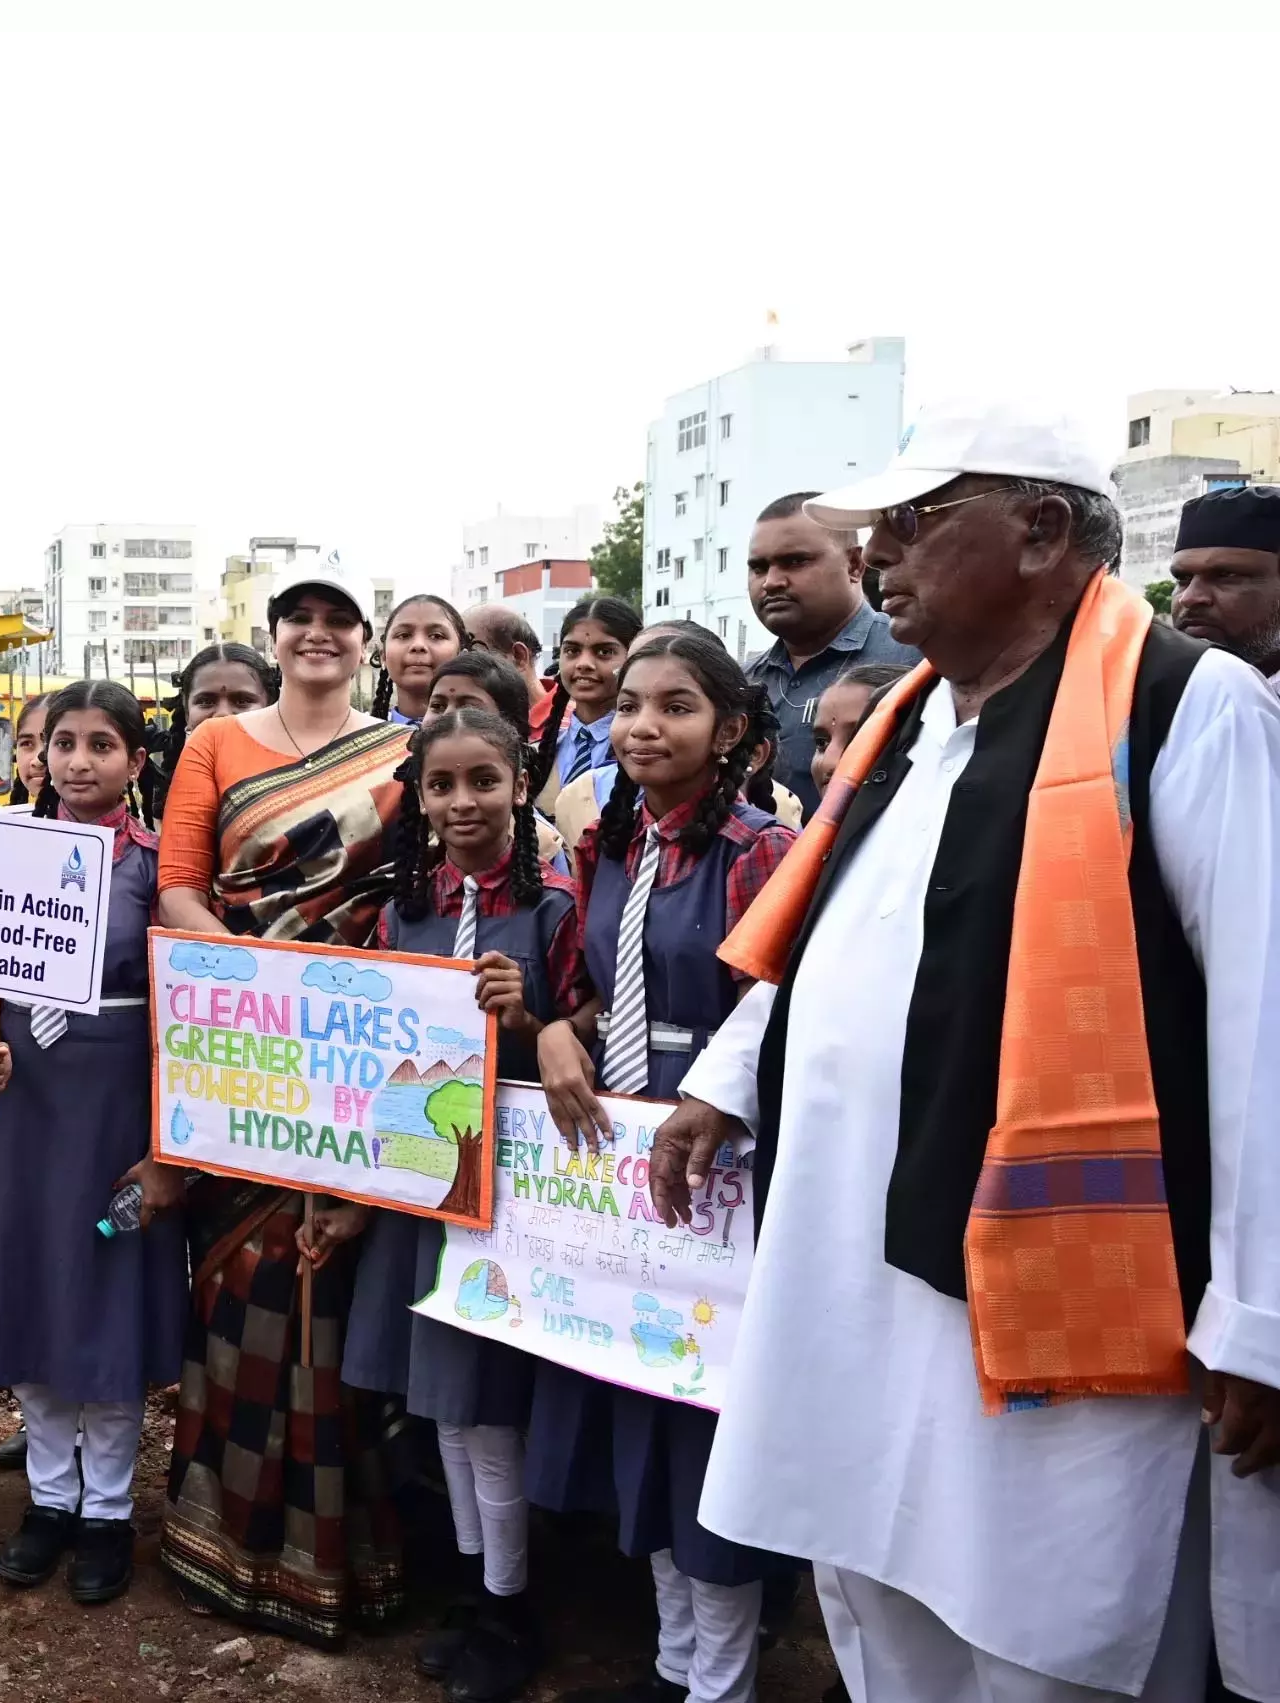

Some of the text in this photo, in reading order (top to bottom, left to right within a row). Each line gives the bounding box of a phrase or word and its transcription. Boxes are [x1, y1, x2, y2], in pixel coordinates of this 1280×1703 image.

[21, 893, 90, 927] Action,
[165, 1024, 385, 1089] GREENER HYD
[167, 1060, 372, 1128] POWERED BY
[553, 1146, 616, 1184] LAKE
[531, 1266, 575, 1306] SAVE
[543, 1308, 613, 1347] WATER
